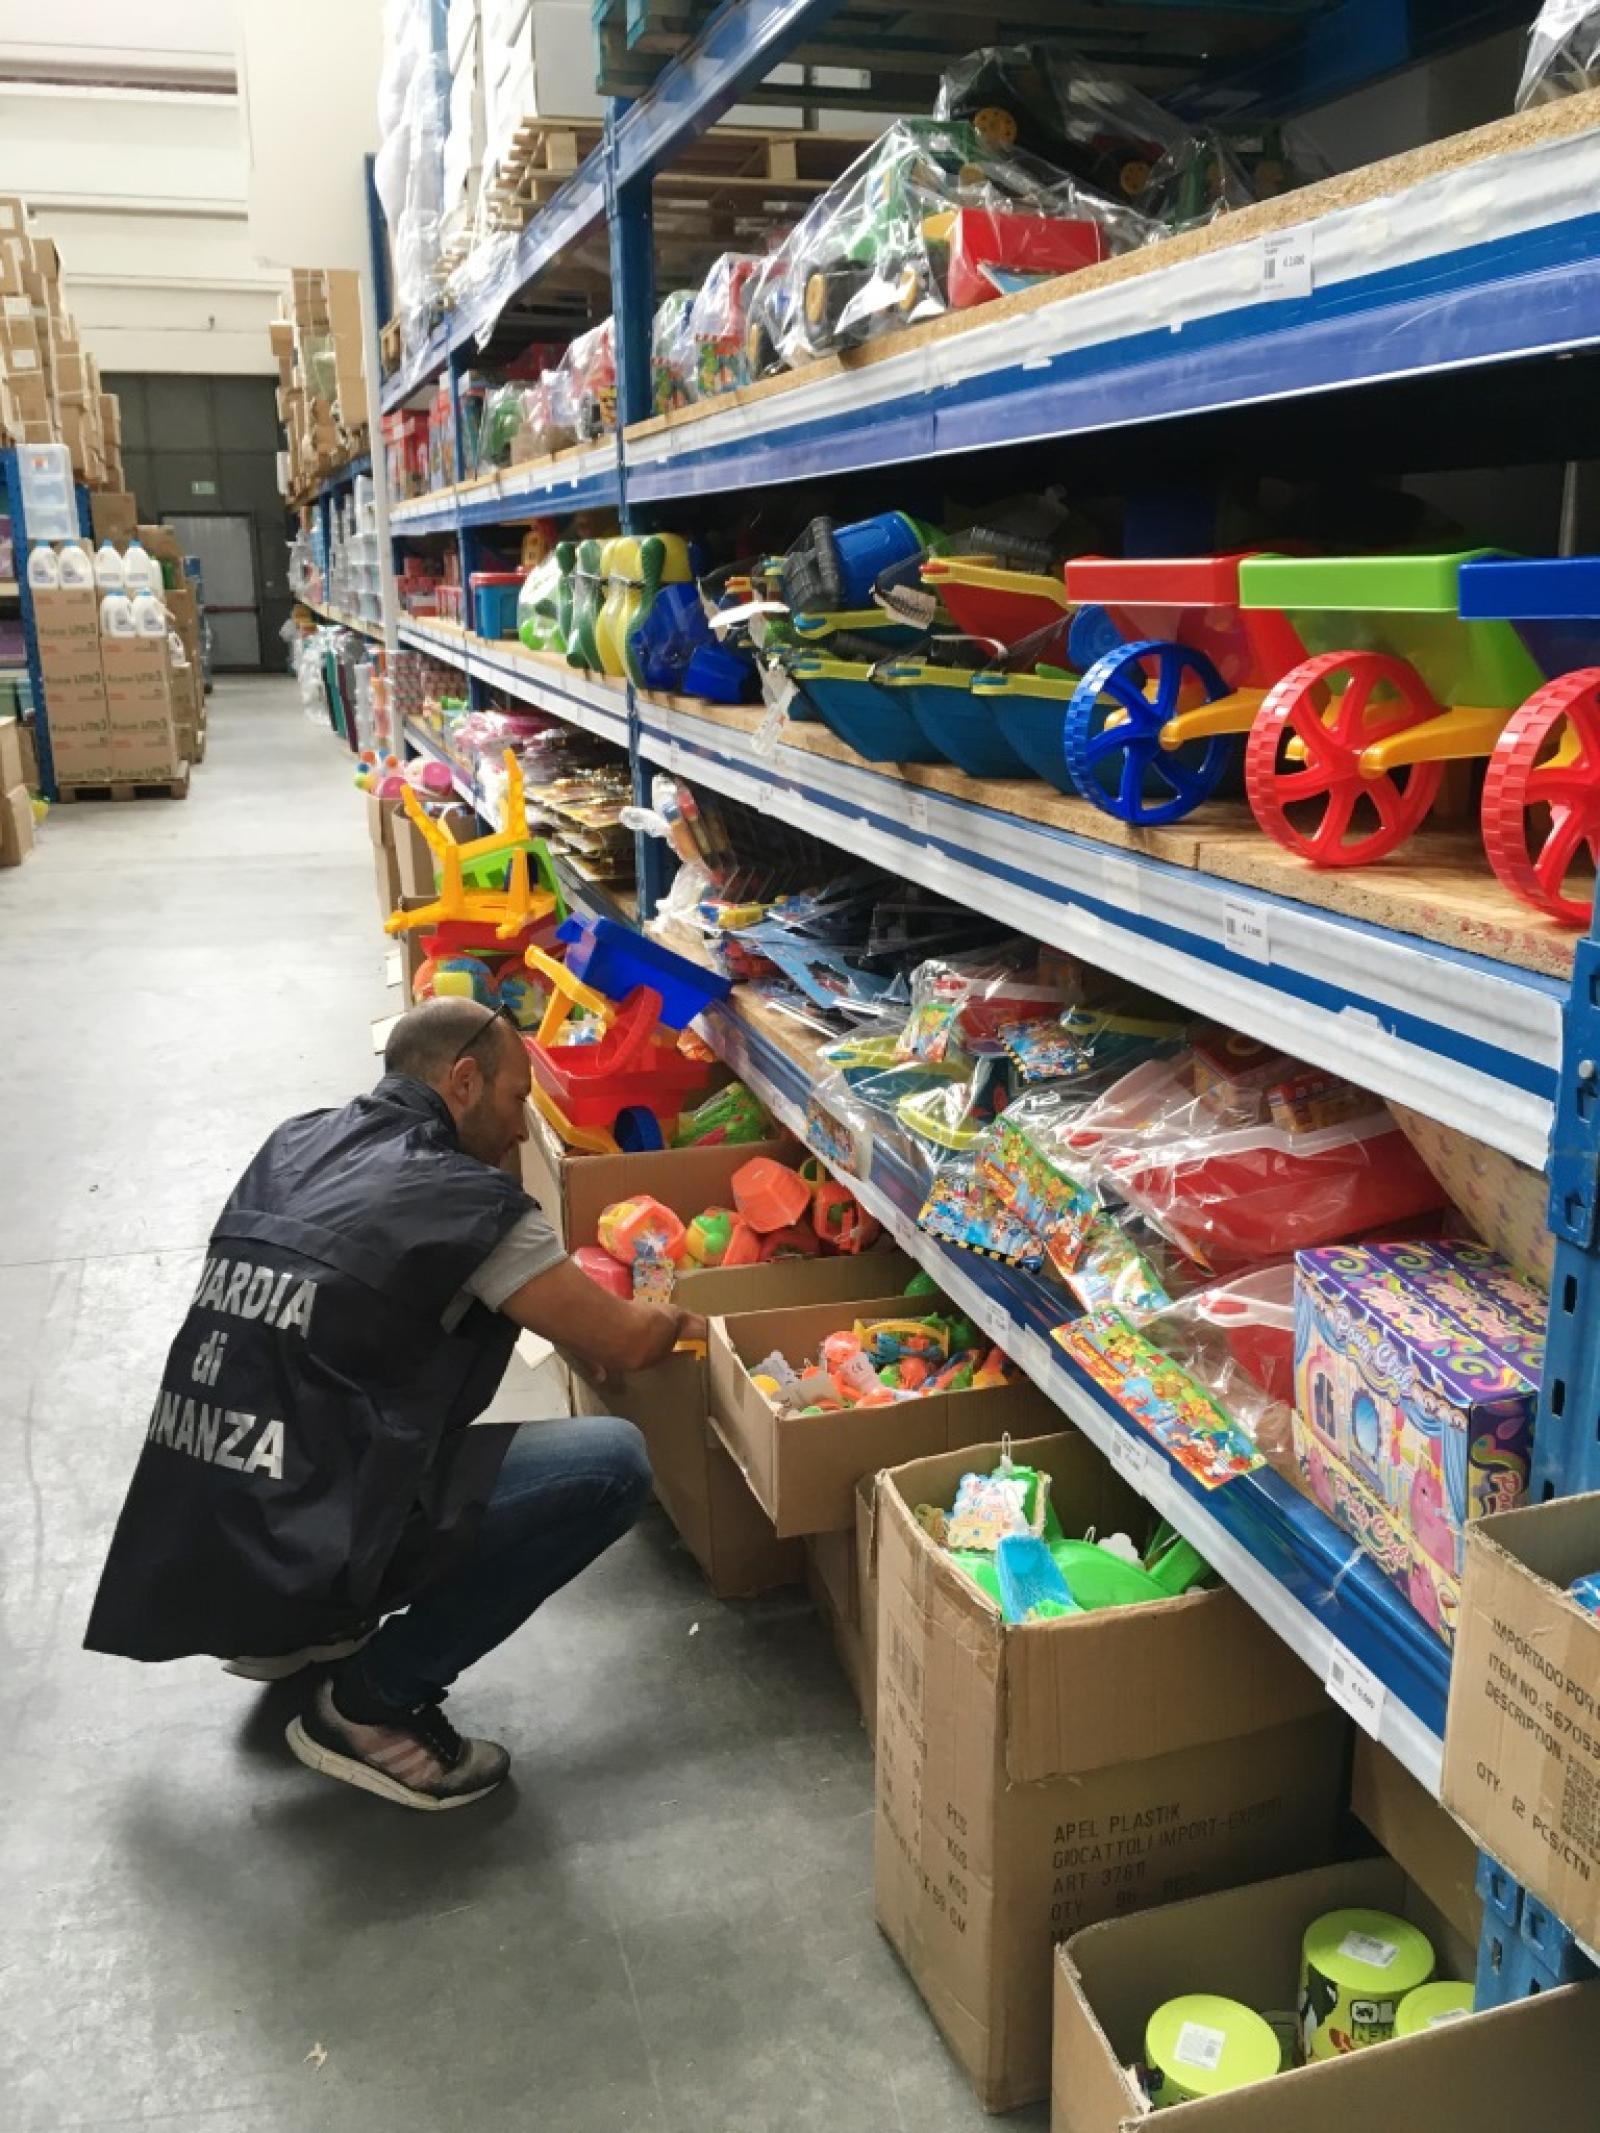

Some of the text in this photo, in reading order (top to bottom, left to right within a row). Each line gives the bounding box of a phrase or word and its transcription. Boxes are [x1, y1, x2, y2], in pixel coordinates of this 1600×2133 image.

[191, 1330, 229, 1386] di
[1488, 1651, 1518, 1688] ITEM
[1493, 1615, 1564, 1689] IMPORTADO
[1053, 1802, 1181, 1845] APEL PLASTIK
[1052, 1835, 1154, 1870] GIOCATTOLI
